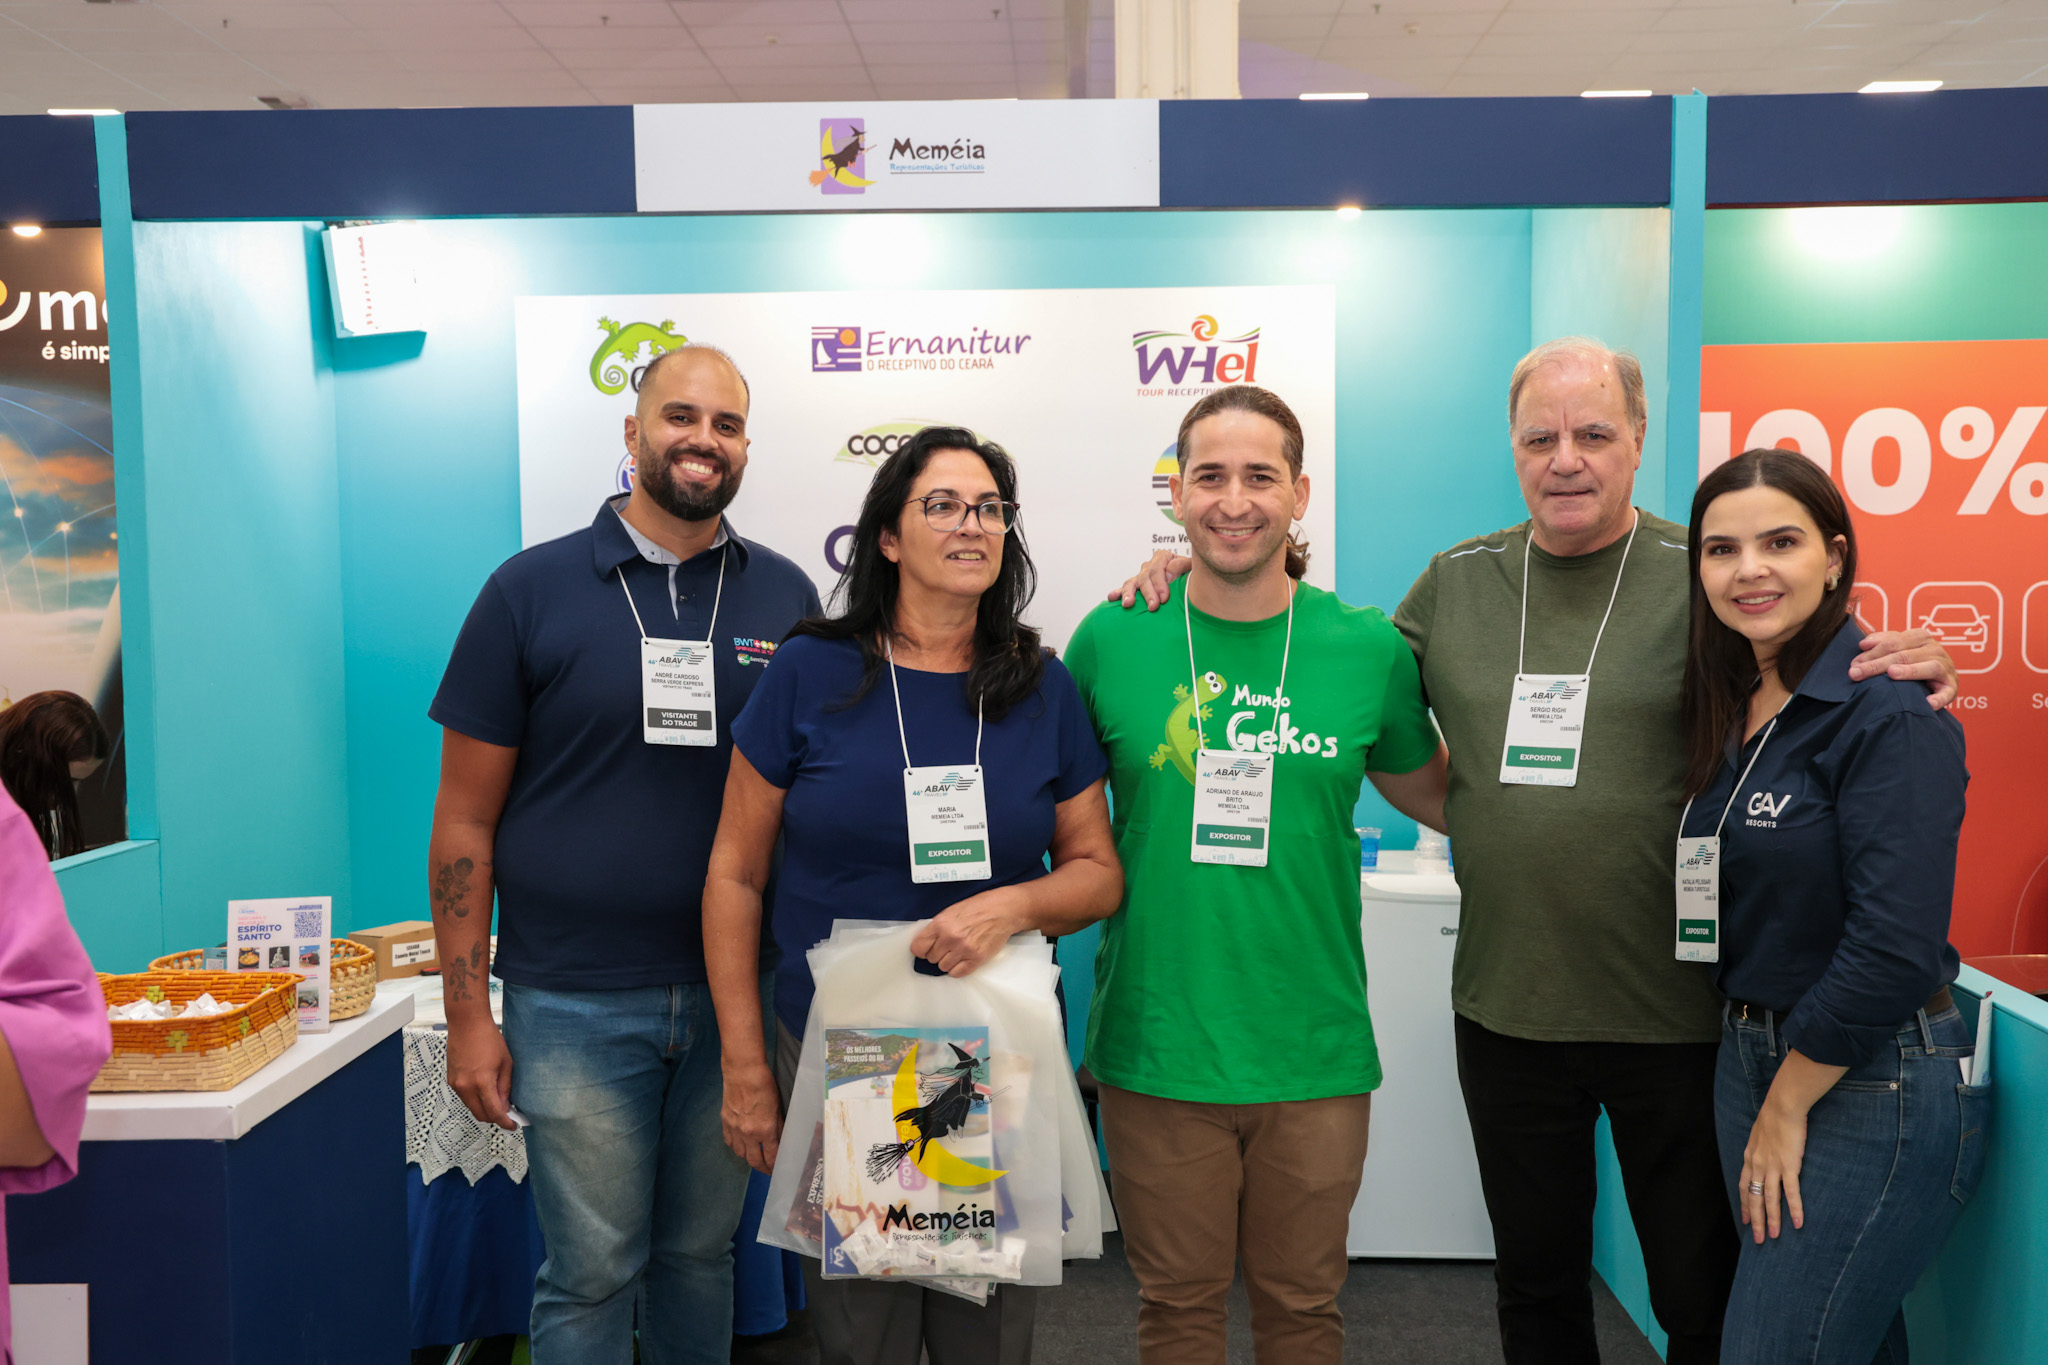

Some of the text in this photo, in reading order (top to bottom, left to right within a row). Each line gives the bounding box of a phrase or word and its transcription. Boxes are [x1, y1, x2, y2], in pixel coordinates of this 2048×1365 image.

[889, 137, 986, 162] Meméia
[866, 326, 1032, 356] Ernanitur
[41, 340, 56, 360] é
[867, 355, 995, 371] O RECEPTIVO DO CEARÁ
[1136, 388, 1164, 397] TOUR
[1152, 534, 1176, 543] Serra
[659, 656, 683, 664] ABAV
[674, 673, 700, 681] CARDOSO
[1231, 684, 1291, 708] Mundo
[1530, 692, 1557, 700] ABAV
[661, 711, 698, 720] VISITANTE
[1226, 711, 1338, 758] Gekos
[1519, 753, 1562, 762] EXPOSITOR
[1214, 768, 1241, 777] ABAV
[924, 784, 951, 793] ABAV
[1747, 791, 1792, 818] GAV
[1745, 818, 1777, 828] RESORTS
[1209, 832, 1252, 842] EXPOSITOR
[928, 848, 972, 858] EXPOSITOR
[237, 923, 282, 934] ESPÍRITO
[1685, 927, 1710, 936] EXPOSITOR
[237, 932, 272, 941] SANTO
[854, 1045, 882, 1054] MELHORES
[882, 1203, 996, 1233] Meméia
